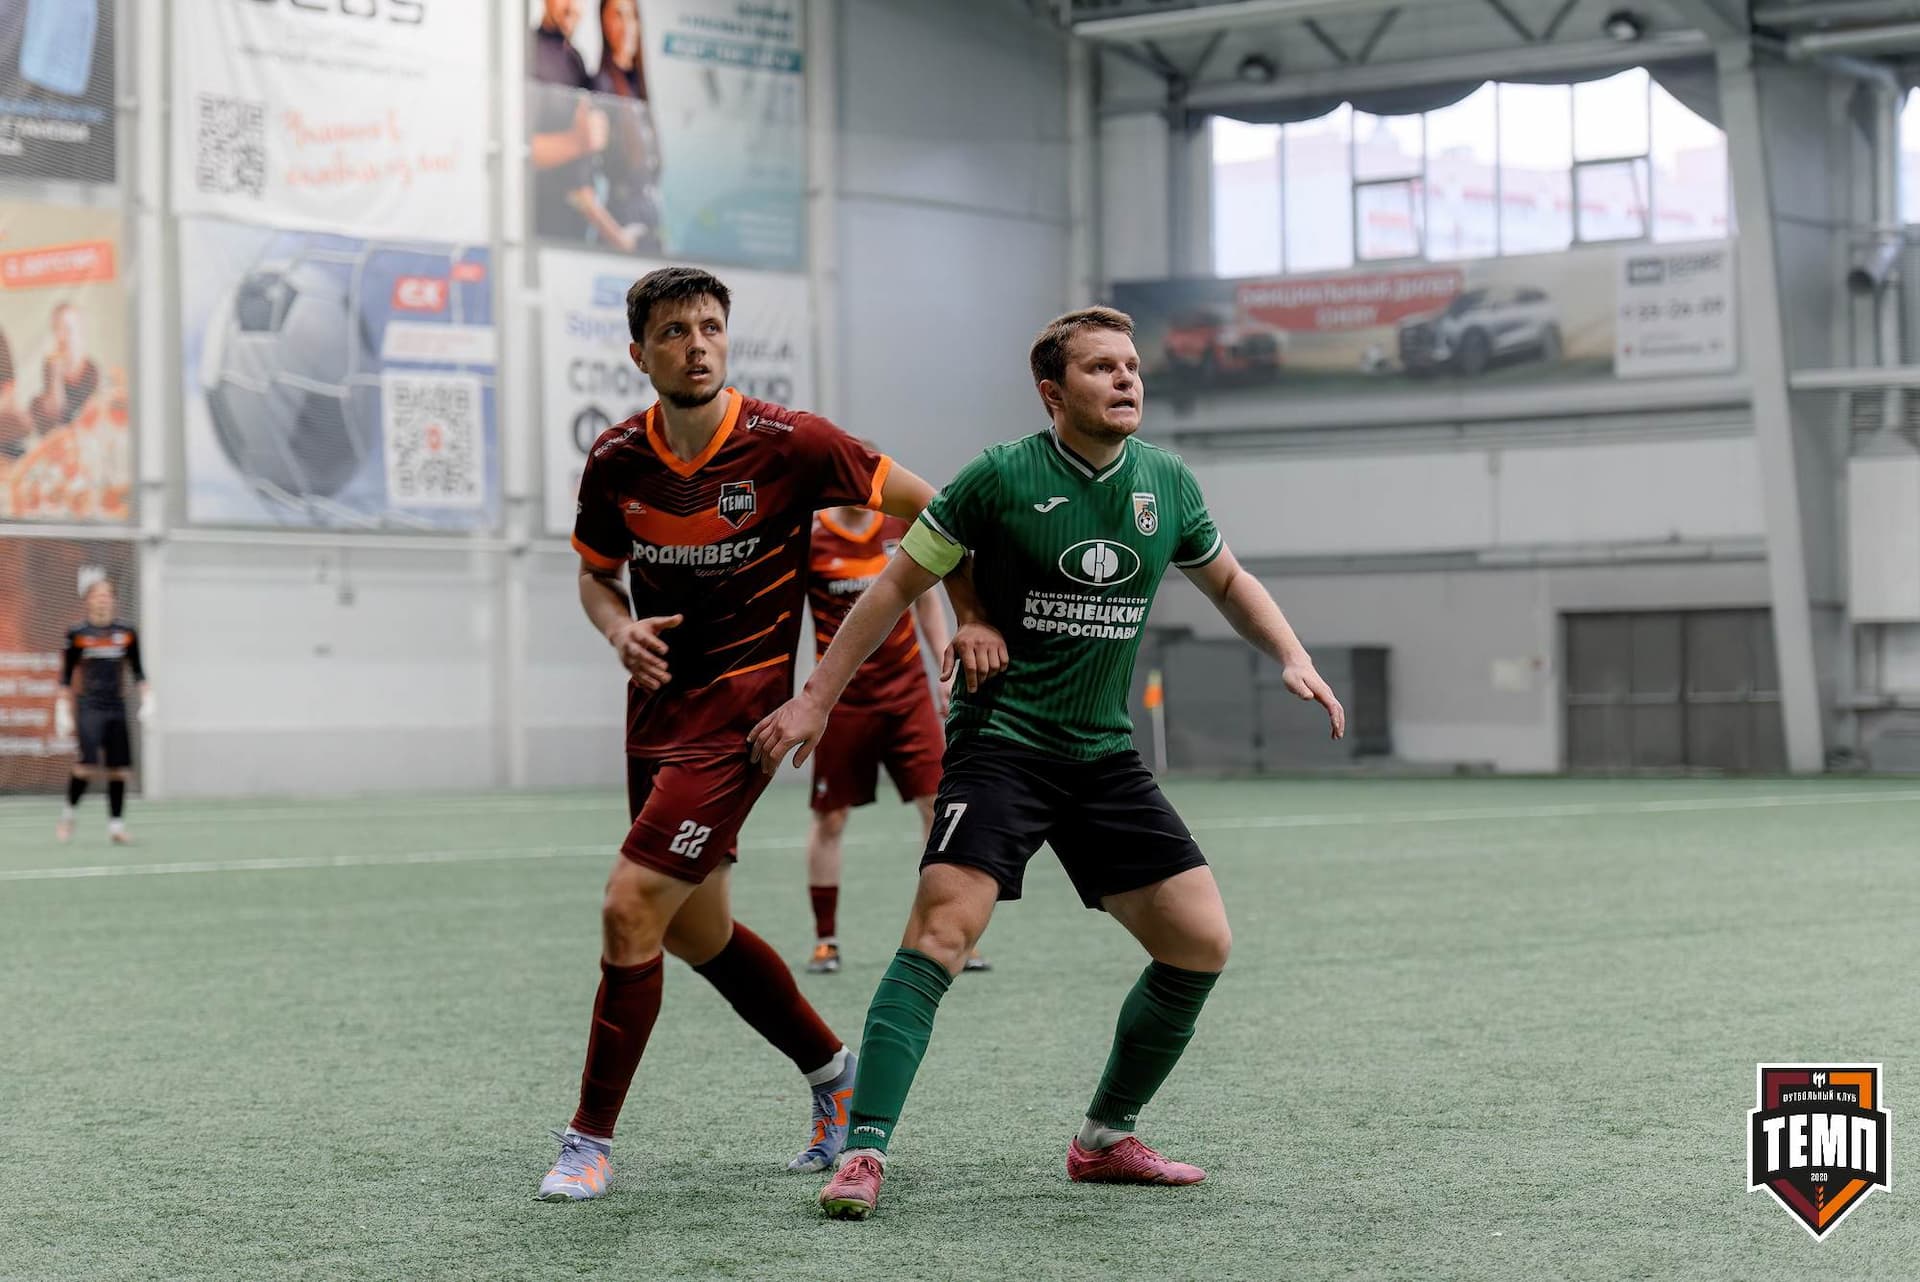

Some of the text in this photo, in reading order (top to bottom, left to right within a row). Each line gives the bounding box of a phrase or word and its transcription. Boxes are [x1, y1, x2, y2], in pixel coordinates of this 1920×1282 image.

[721, 495, 753, 513] ТЕМП
[1028, 590, 1102, 602] АКЦИОНЕРНОЕ
[1024, 598, 1146, 624] КУЗНЕЦКИЕ
[669, 820, 712, 859] 22
[937, 803, 968, 851] 7
